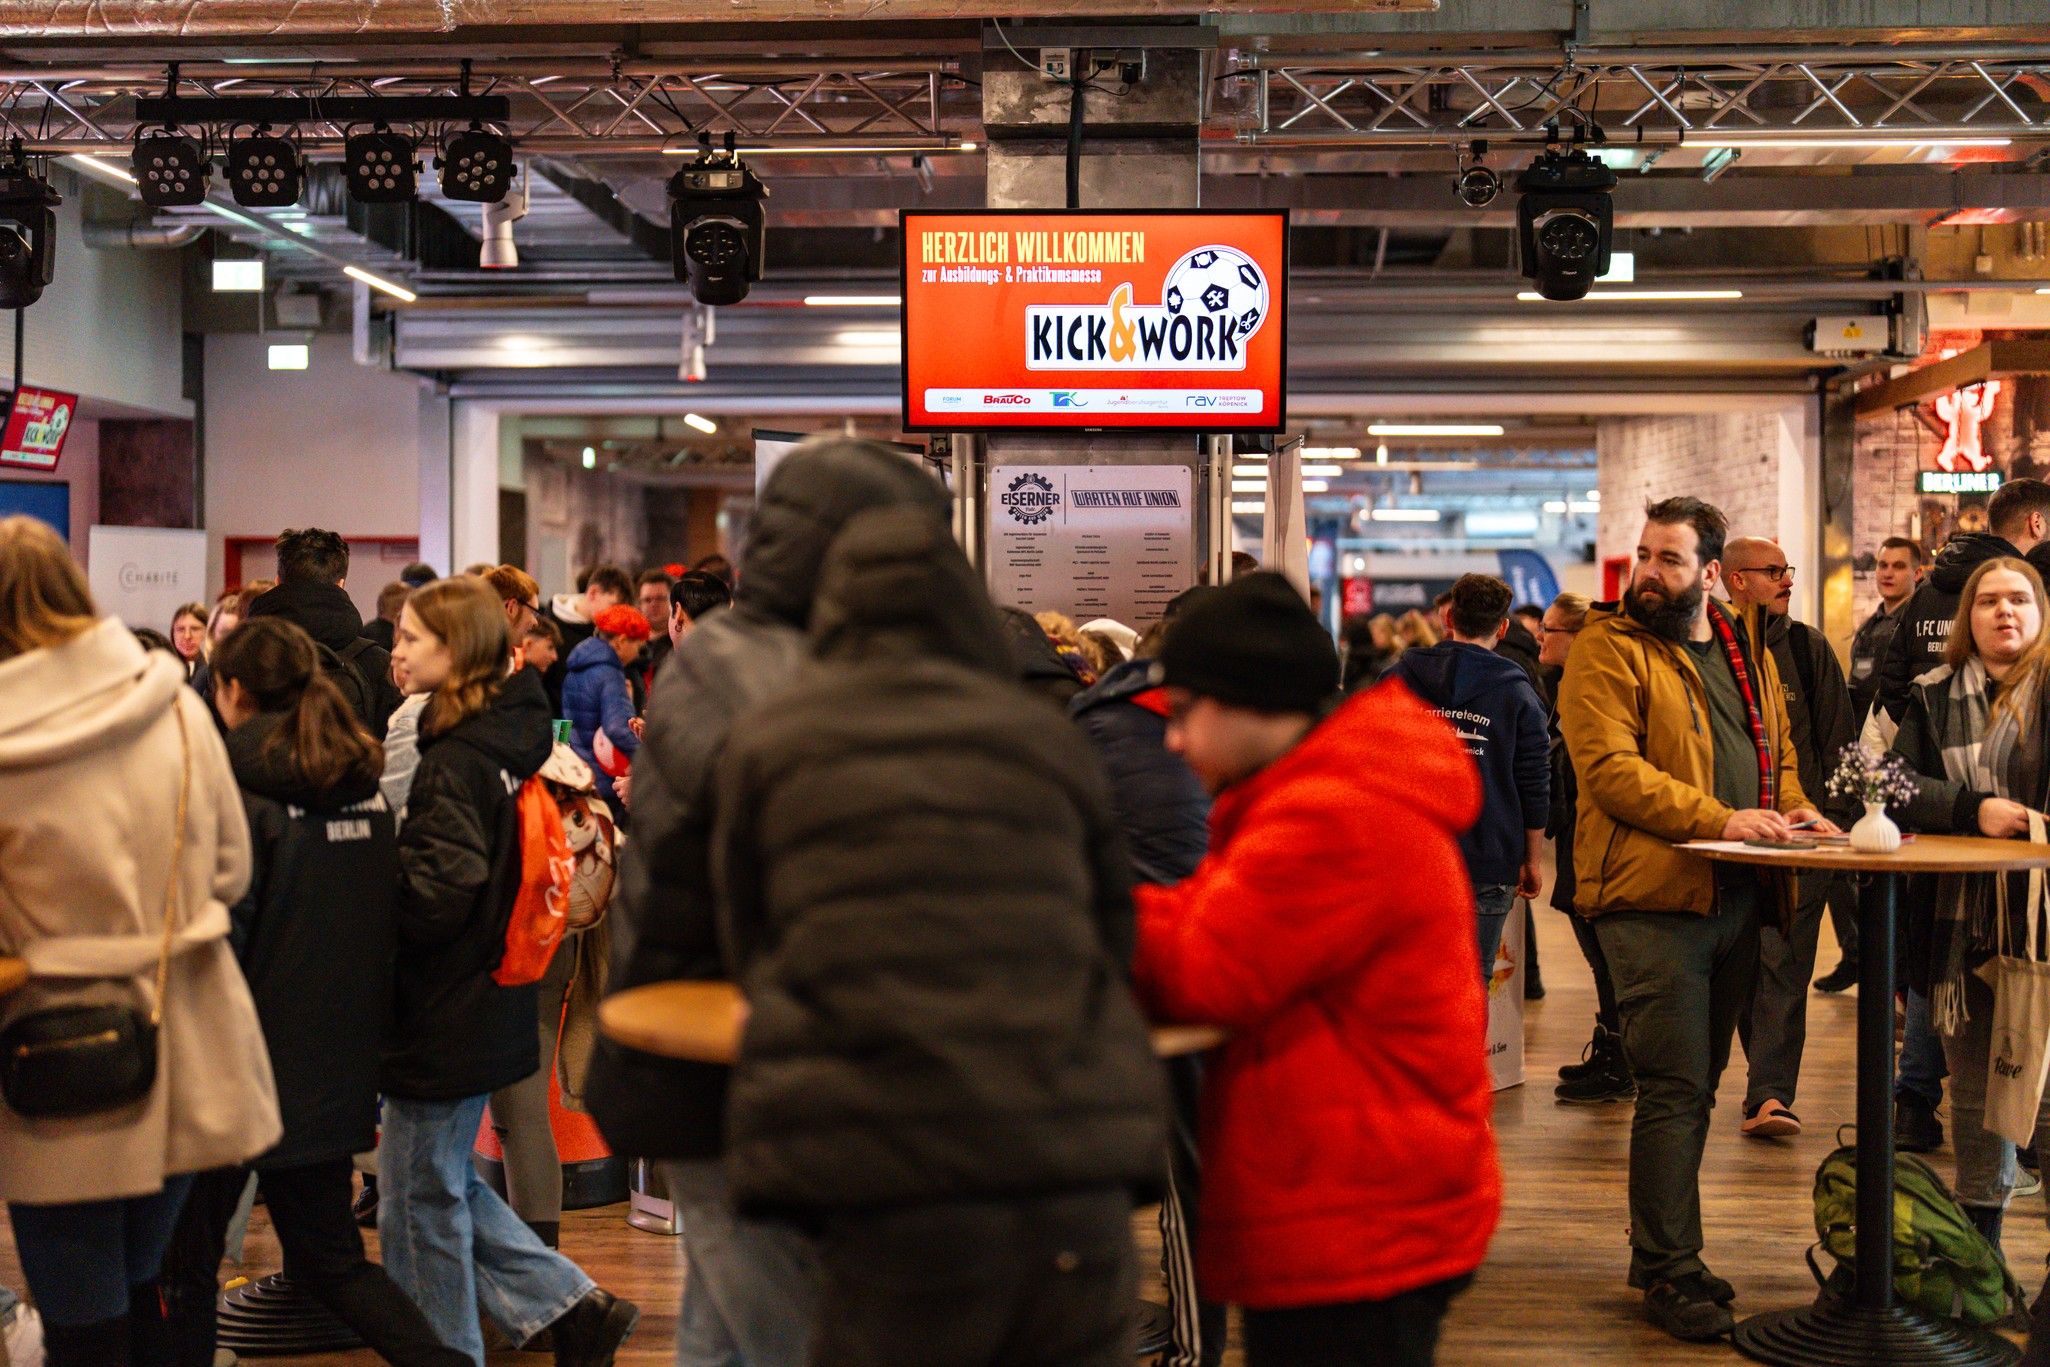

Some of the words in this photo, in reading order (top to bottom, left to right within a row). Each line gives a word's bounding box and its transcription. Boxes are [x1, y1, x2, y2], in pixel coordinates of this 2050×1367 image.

[921, 231, 1009, 264] HERZLICH
[1015, 231, 1145, 264] WILLKOMMEN
[921, 268, 937, 283] zur
[940, 265, 1003, 285] Ausbildungs-
[1005, 267, 1013, 283] &
[1016, 265, 1102, 284] Praktikumsmesse
[1186, 395, 1218, 407] rav
[1922, 471, 2000, 492] BERLINER
[1001, 491, 1060, 506] EISERNER
[1074, 491, 1121, 506] WARTEN
[1121, 491, 1143, 506] AUF
[1143, 491, 1179, 506] UNION
[1922, 620, 1936, 636] FC
[326, 819, 372, 842] BERLIN
